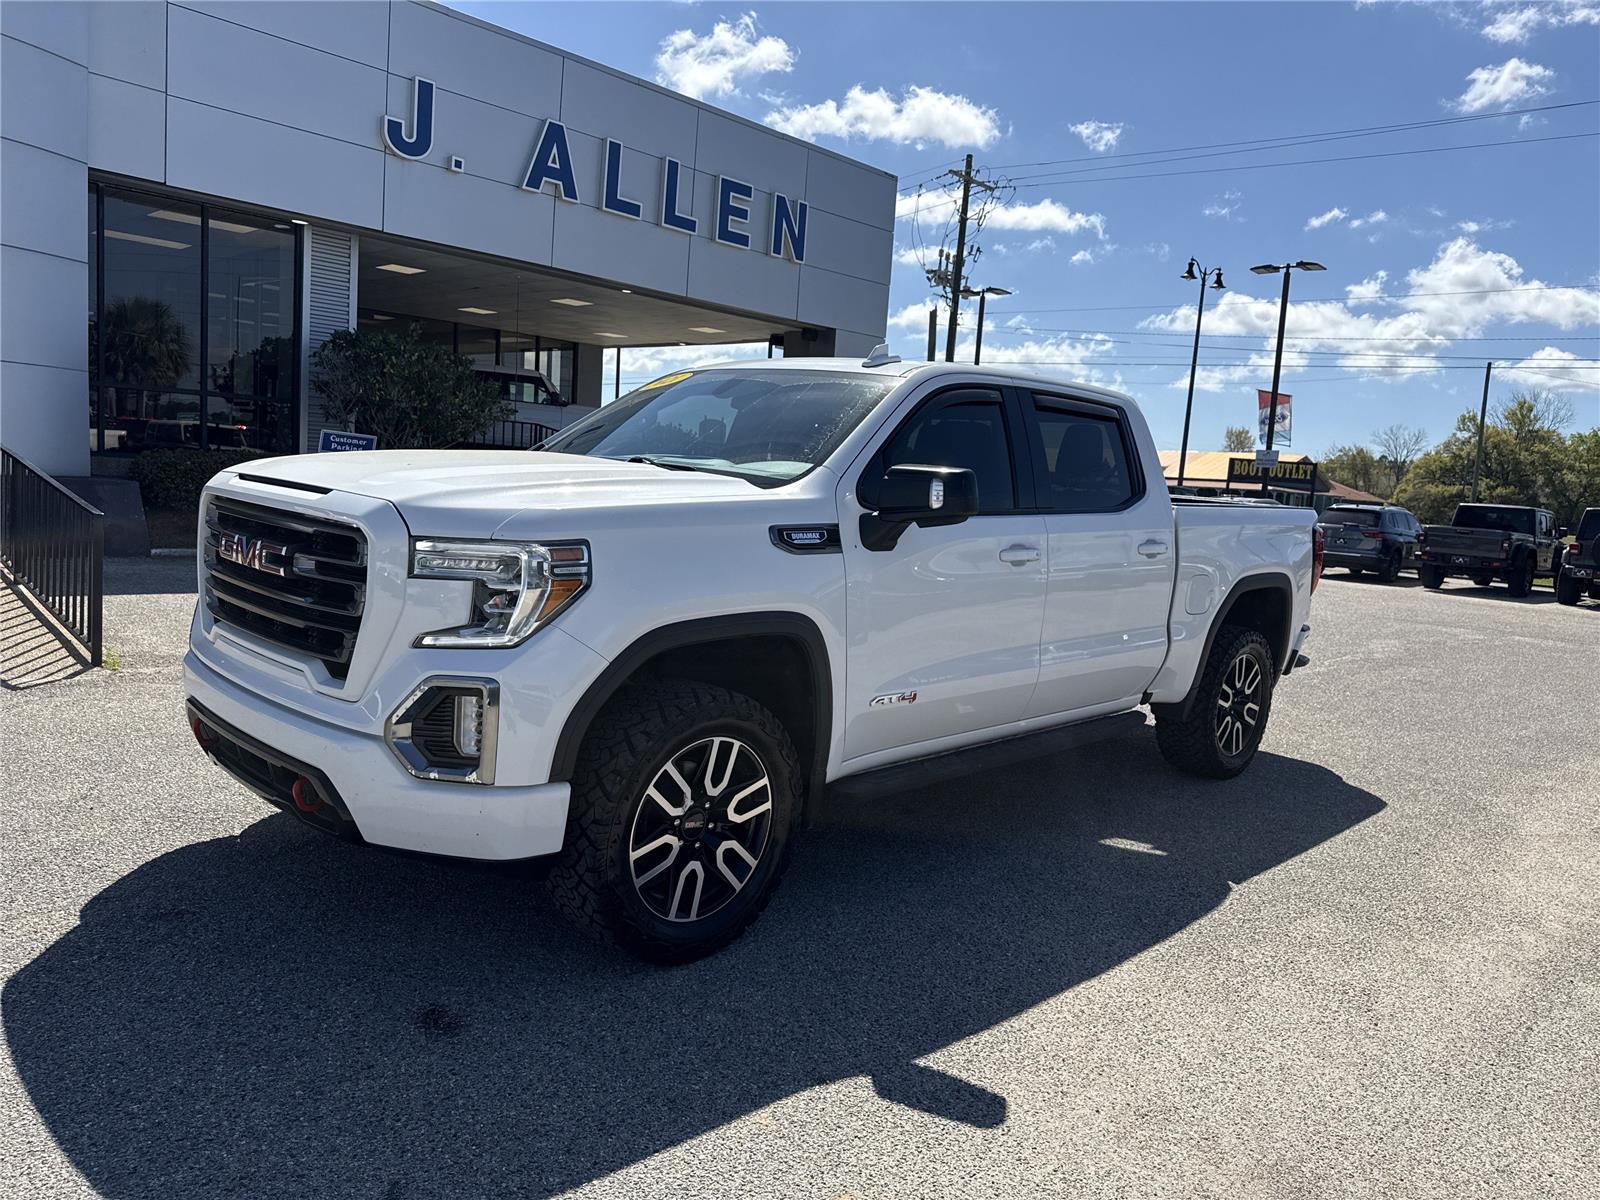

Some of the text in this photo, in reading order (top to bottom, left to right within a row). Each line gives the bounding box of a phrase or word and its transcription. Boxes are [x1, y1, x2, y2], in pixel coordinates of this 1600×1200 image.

[381, 76, 808, 264] J. ALLEN
[330, 435, 367, 446] Customer
[1269, 463, 1313, 480] OUTLET
[791, 532, 821, 540] DURAMAX
[220, 530, 287, 577] GMC
[869, 690, 917, 707] AT4
